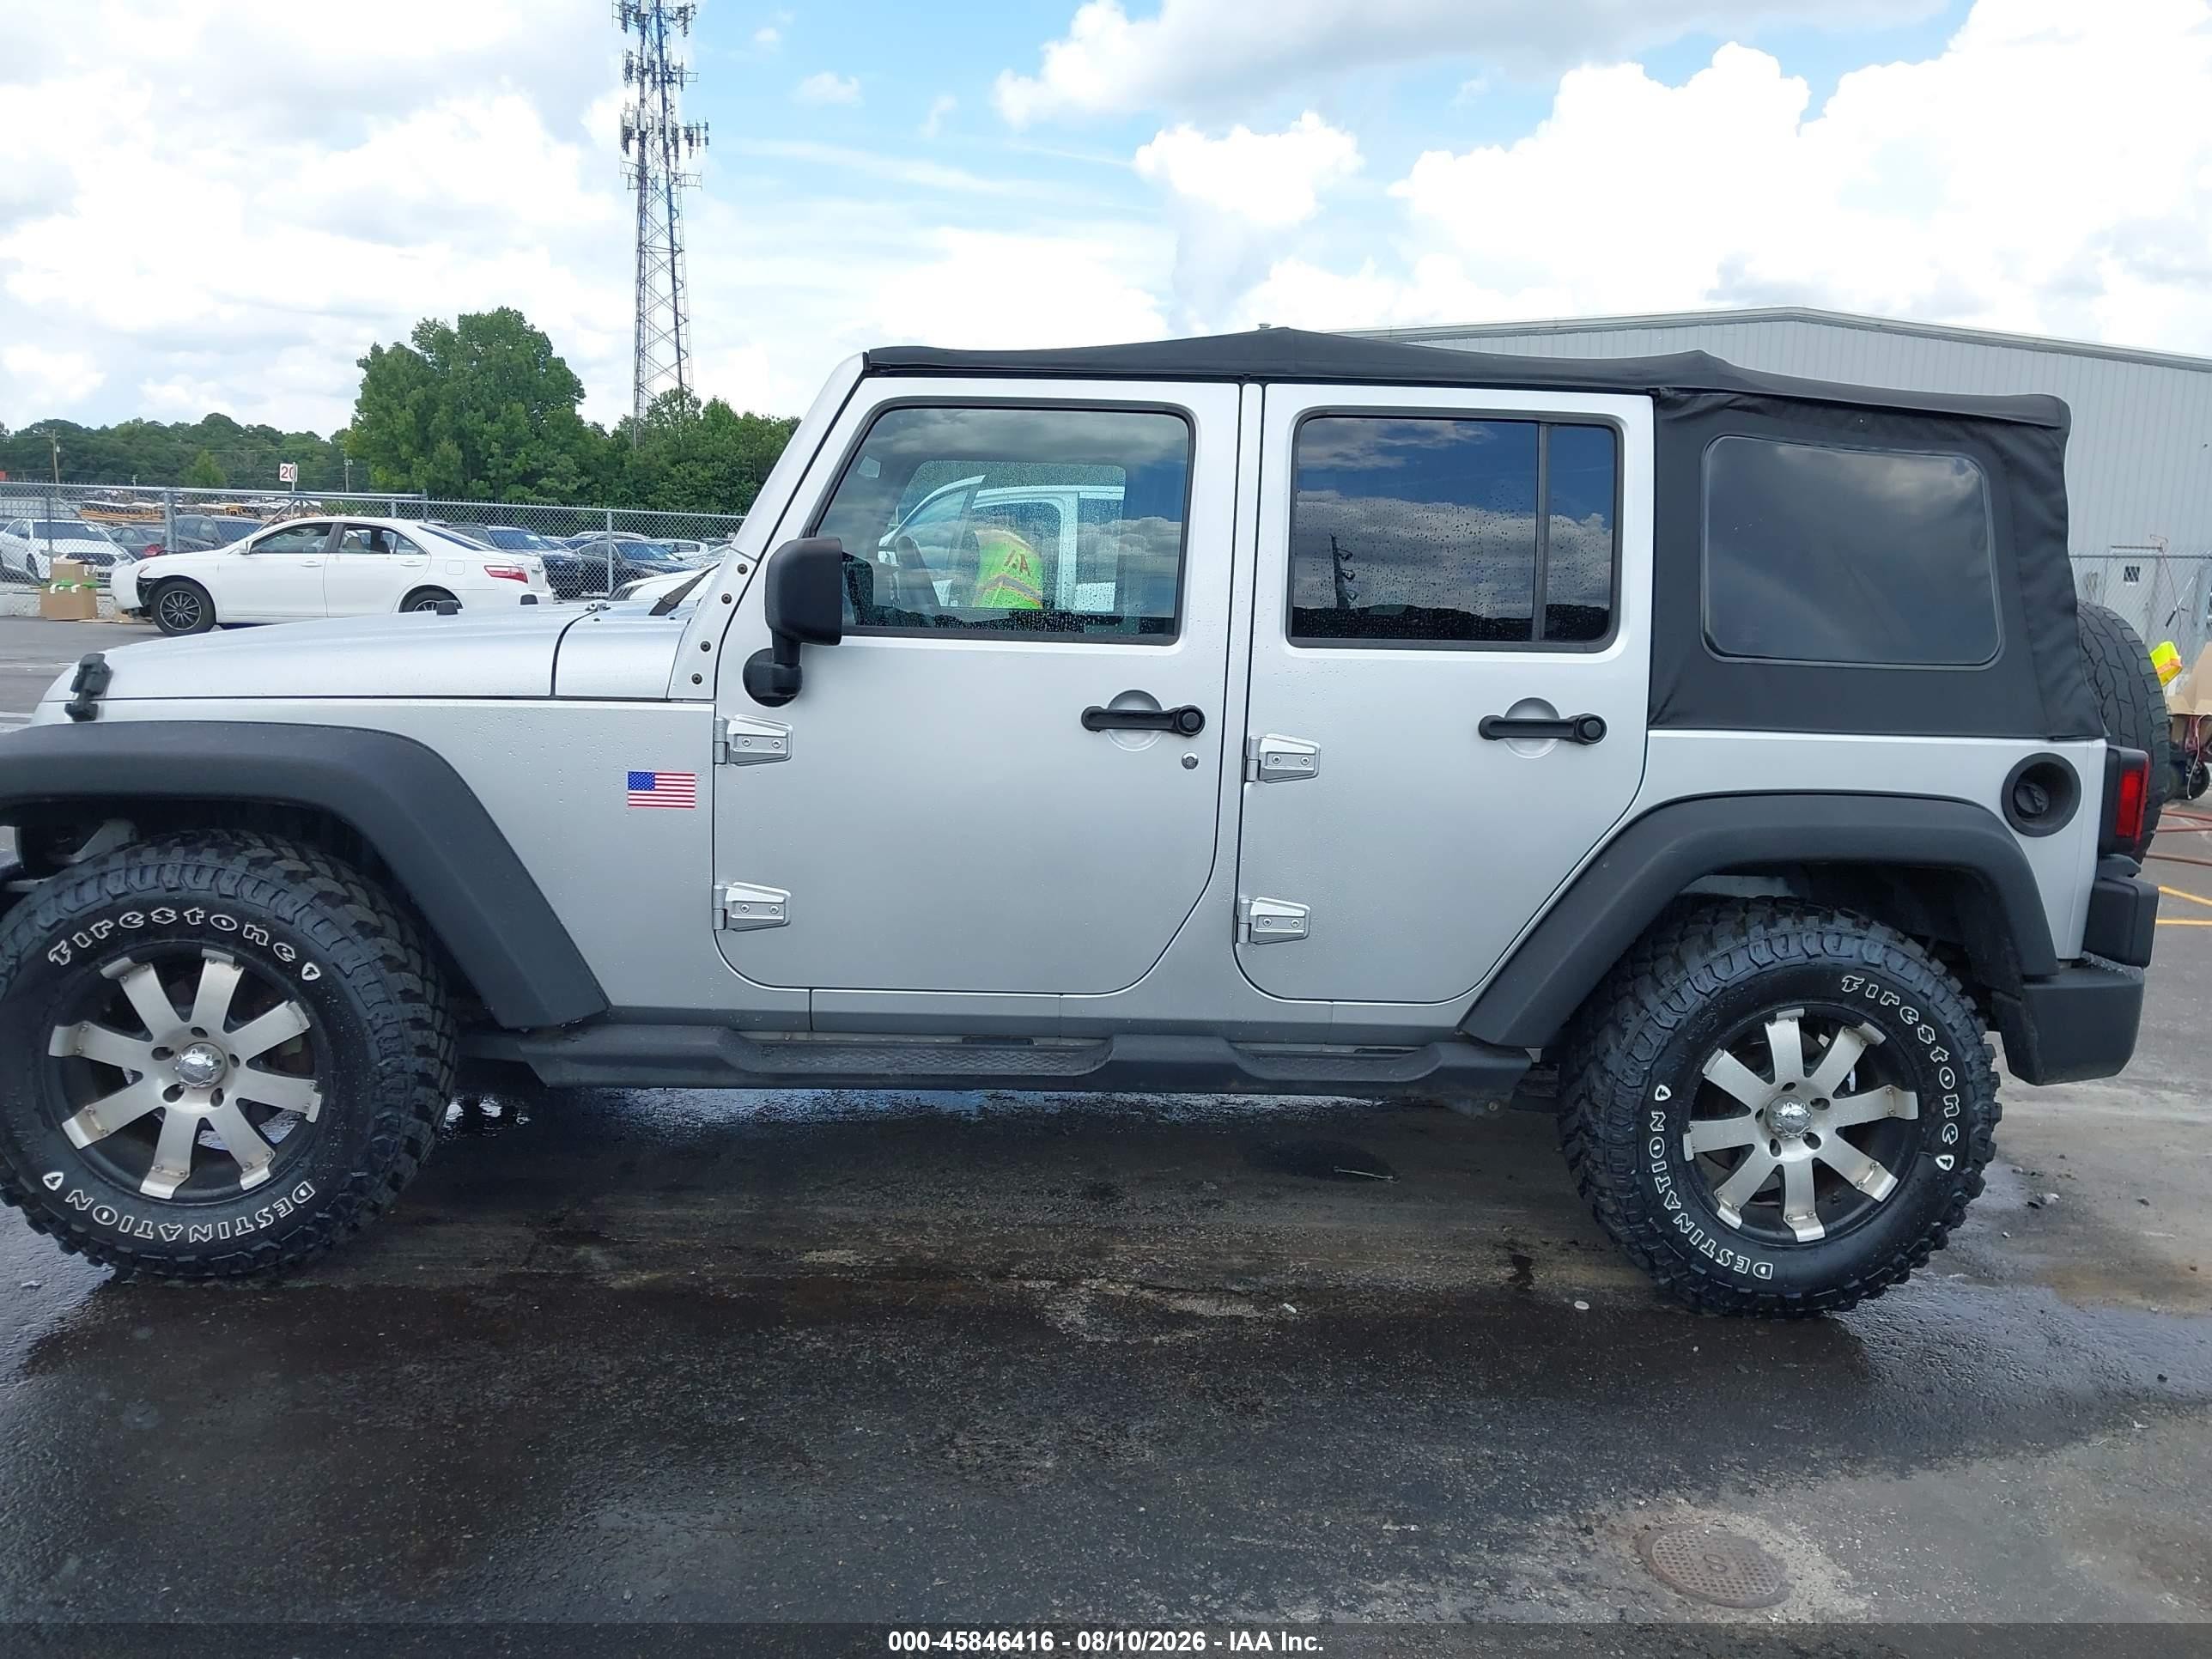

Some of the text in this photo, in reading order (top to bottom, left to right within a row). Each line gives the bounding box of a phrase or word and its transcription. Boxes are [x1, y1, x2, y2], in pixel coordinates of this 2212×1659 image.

[281, 465, 297, 479] 20
[48, 907, 296, 966] Firestone
[1840, 975, 1960, 1146] Firestone
[65, 1182, 316, 1244] DESTINATION
[1649, 1110, 1774, 1280] DESTINATION
